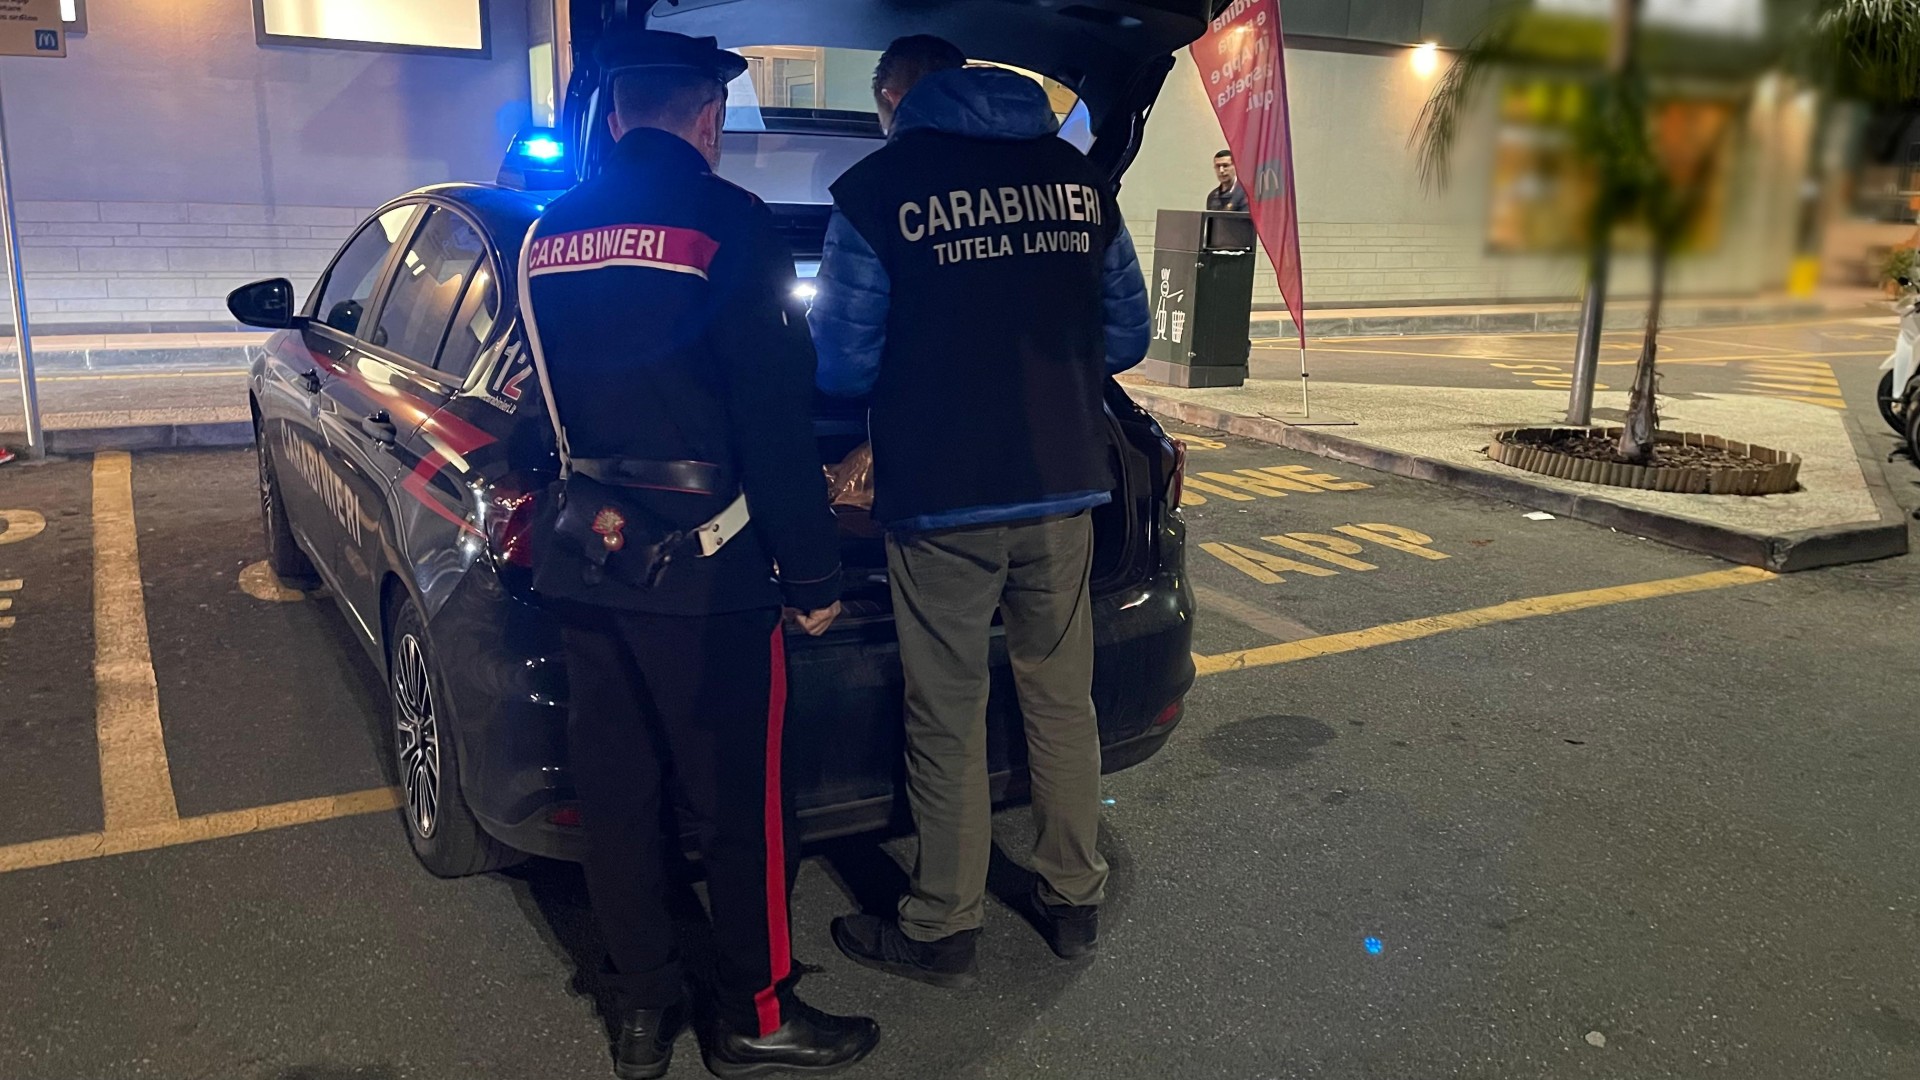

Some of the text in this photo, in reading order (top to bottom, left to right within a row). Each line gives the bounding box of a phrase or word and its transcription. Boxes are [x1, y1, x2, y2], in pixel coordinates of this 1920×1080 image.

[899, 184, 1102, 242] CARABINIERI
[530, 229, 666, 268] CARABINIERI
[933, 231, 1089, 265] TUTELA LAVORO
[281, 418, 362, 548] CARABINIERI
[1198, 523, 1453, 585] APP
